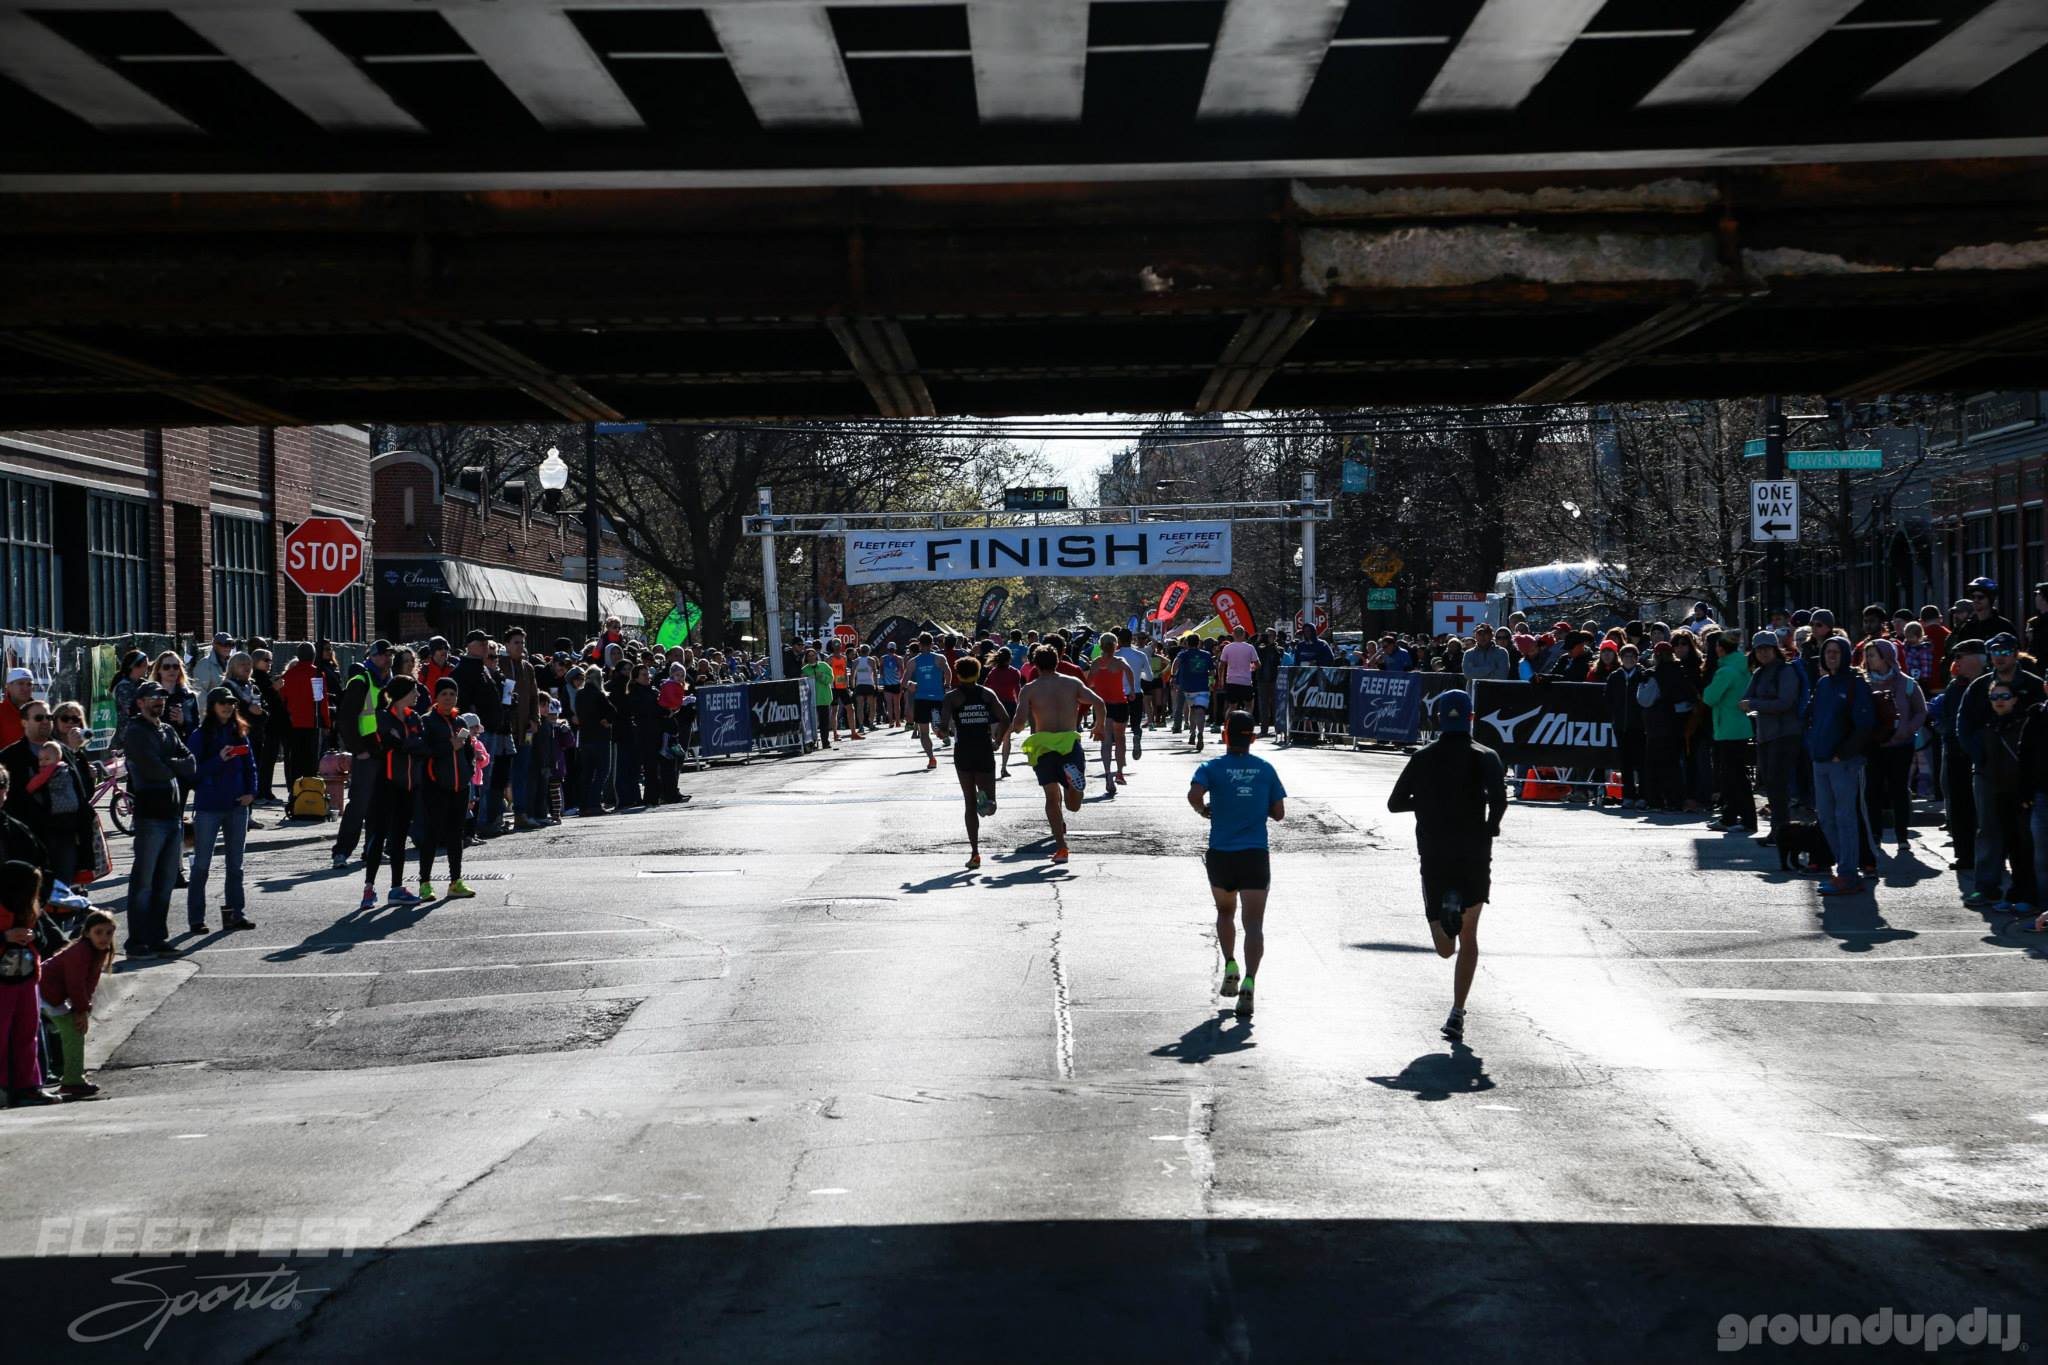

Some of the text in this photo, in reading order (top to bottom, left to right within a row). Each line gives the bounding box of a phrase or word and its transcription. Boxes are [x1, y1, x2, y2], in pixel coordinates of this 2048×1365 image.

[1797, 453, 1870, 466] RAVENSWOOD
[1758, 486, 1792, 500] ONE
[1757, 503, 1793, 516] WAY
[1159, 532, 1222, 541] FLEET FEET
[853, 540, 916, 550] FLEET FEET
[926, 533, 1148, 571] FINISH
[289, 541, 358, 571] STOP
[1359, 676, 1411, 697] FLEET FEET
[705, 692, 742, 711] FLEET FEET
